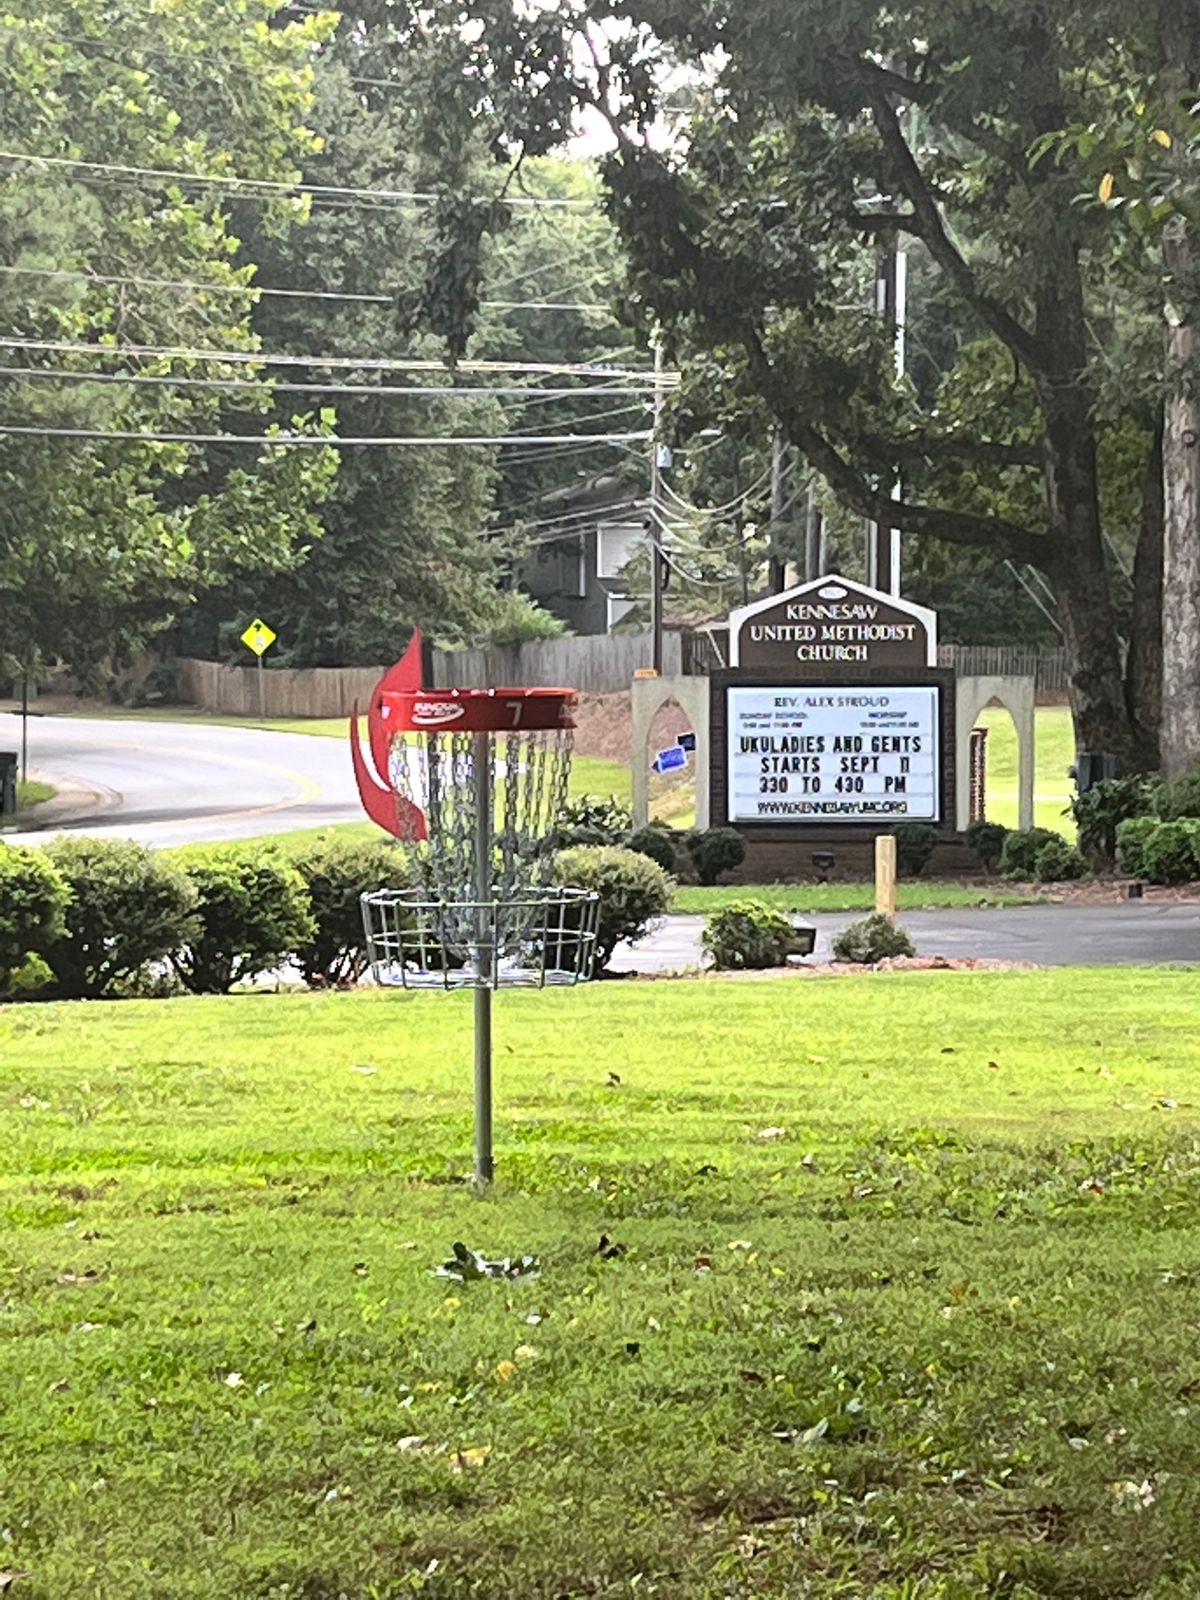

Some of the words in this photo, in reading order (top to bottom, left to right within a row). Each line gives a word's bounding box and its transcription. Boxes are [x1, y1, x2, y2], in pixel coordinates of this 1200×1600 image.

[786, 604, 878, 620] KENNESAW
[750, 625, 816, 641] UNITED
[821, 624, 916, 641] METHODIST
[797, 645, 868, 661] CHURCH
[805, 697, 834, 707] ALEX
[837, 696, 890, 707] STROUD
[506, 701, 523, 726] 7
[740, 736, 825, 752] UKULADIES
[833, 736, 862, 752] AND
[871, 736, 922, 752] GENTS
[761, 757, 820, 773] STARTS
[840, 757, 879, 773] SEPT
[759, 776, 788, 793] 330
[802, 776, 821, 793] TO
[834, 776, 864, 793] 430
[885, 776, 907, 793] PM
